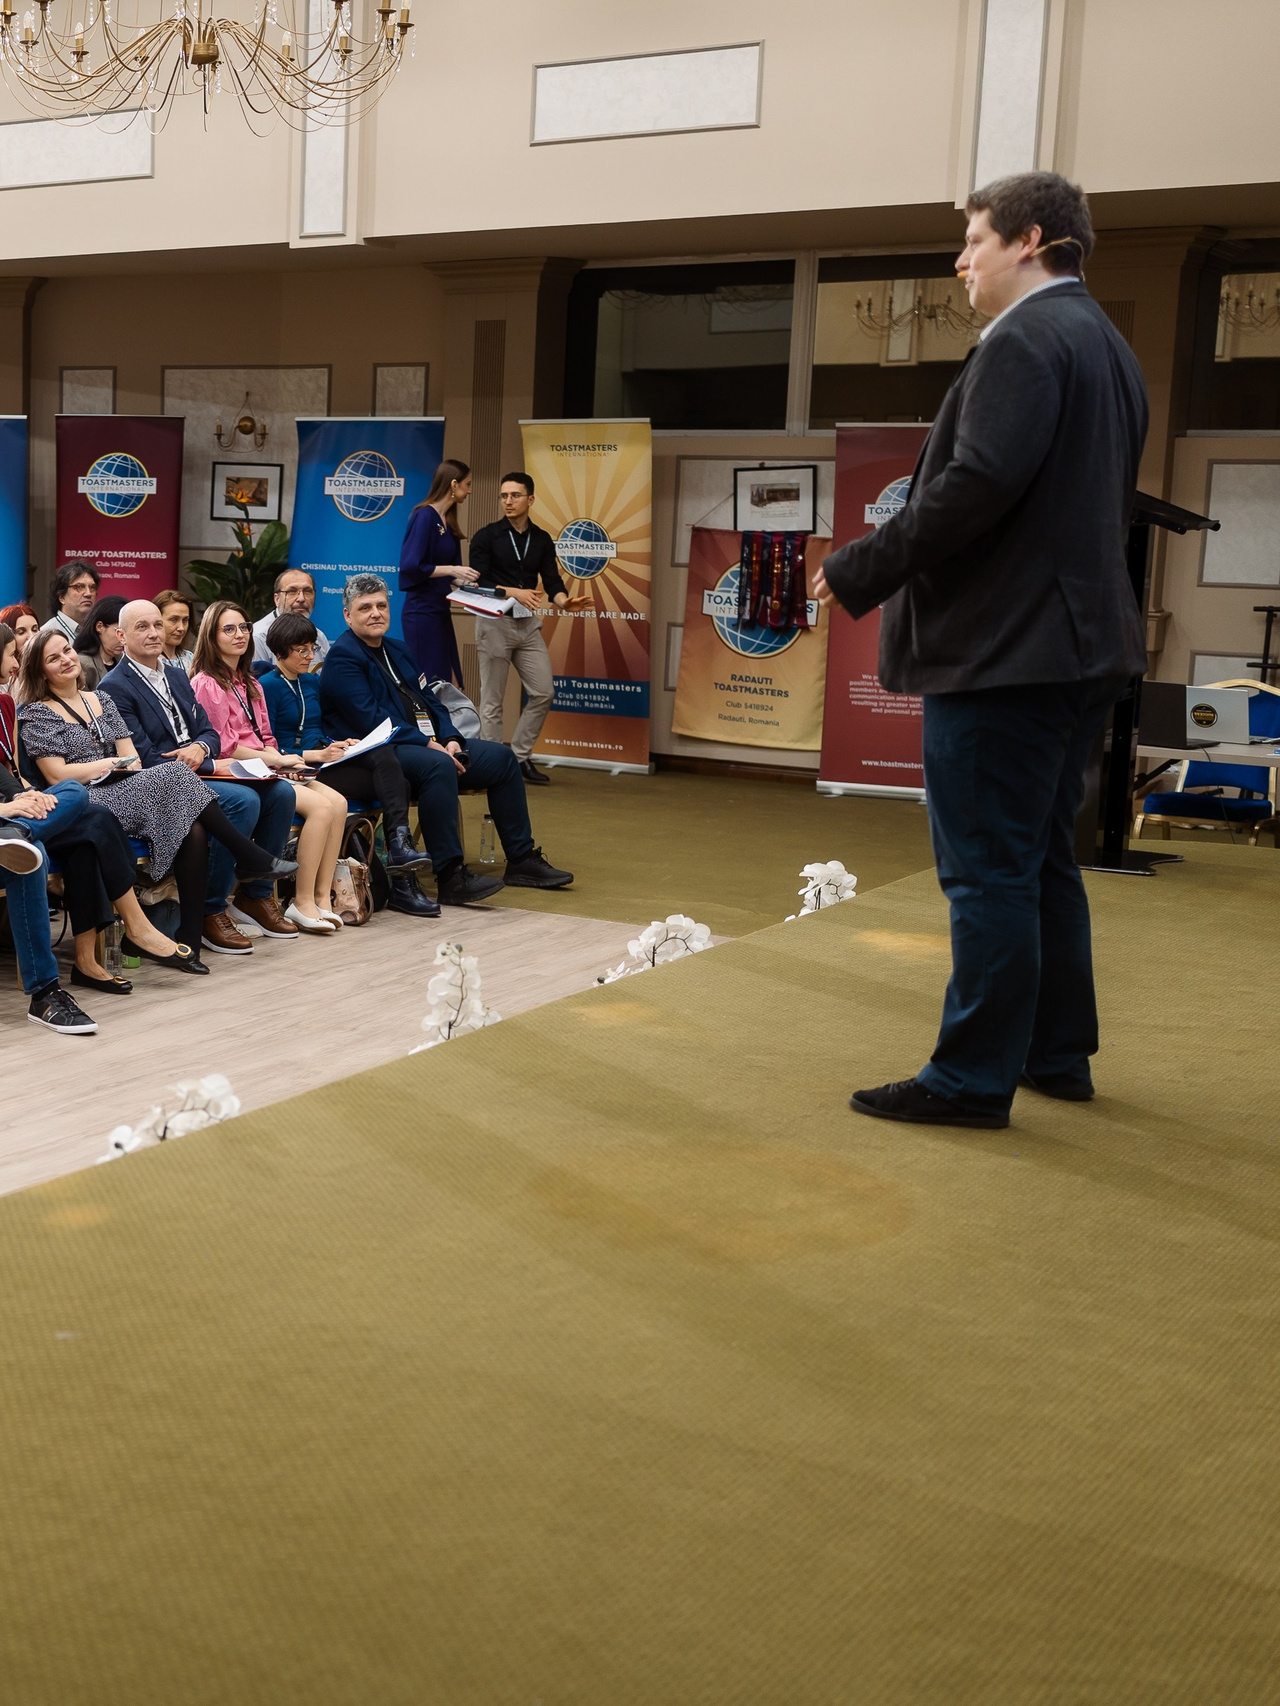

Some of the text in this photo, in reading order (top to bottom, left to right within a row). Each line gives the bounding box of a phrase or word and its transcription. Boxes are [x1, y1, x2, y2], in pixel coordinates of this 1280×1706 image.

[550, 444, 618, 452] TOASTMASTERS
[80, 479, 154, 487] TOASTMASTERS
[328, 479, 402, 488] TOASTMASTERS
[102, 550, 167, 559] TOASTMASTERS
[301, 563, 337, 571] CHISINAU
[338, 564, 396, 573] TOASTMASTERS
[323, 586, 345, 594] Repub
[599, 611, 617, 619] ARE
[620, 612, 646, 620] MADE
[730, 674, 773, 685] RADAUTI
[571, 680, 642, 692] Toastmasters
[713, 682, 790, 698] TOASTMASTERS
[575, 693, 610, 702] 05418924
[725, 700, 774, 711] Club 5418924
[718, 713, 780, 726] Radauti, Romania
[545, 738, 624, 750] www.toastmasters.ro
